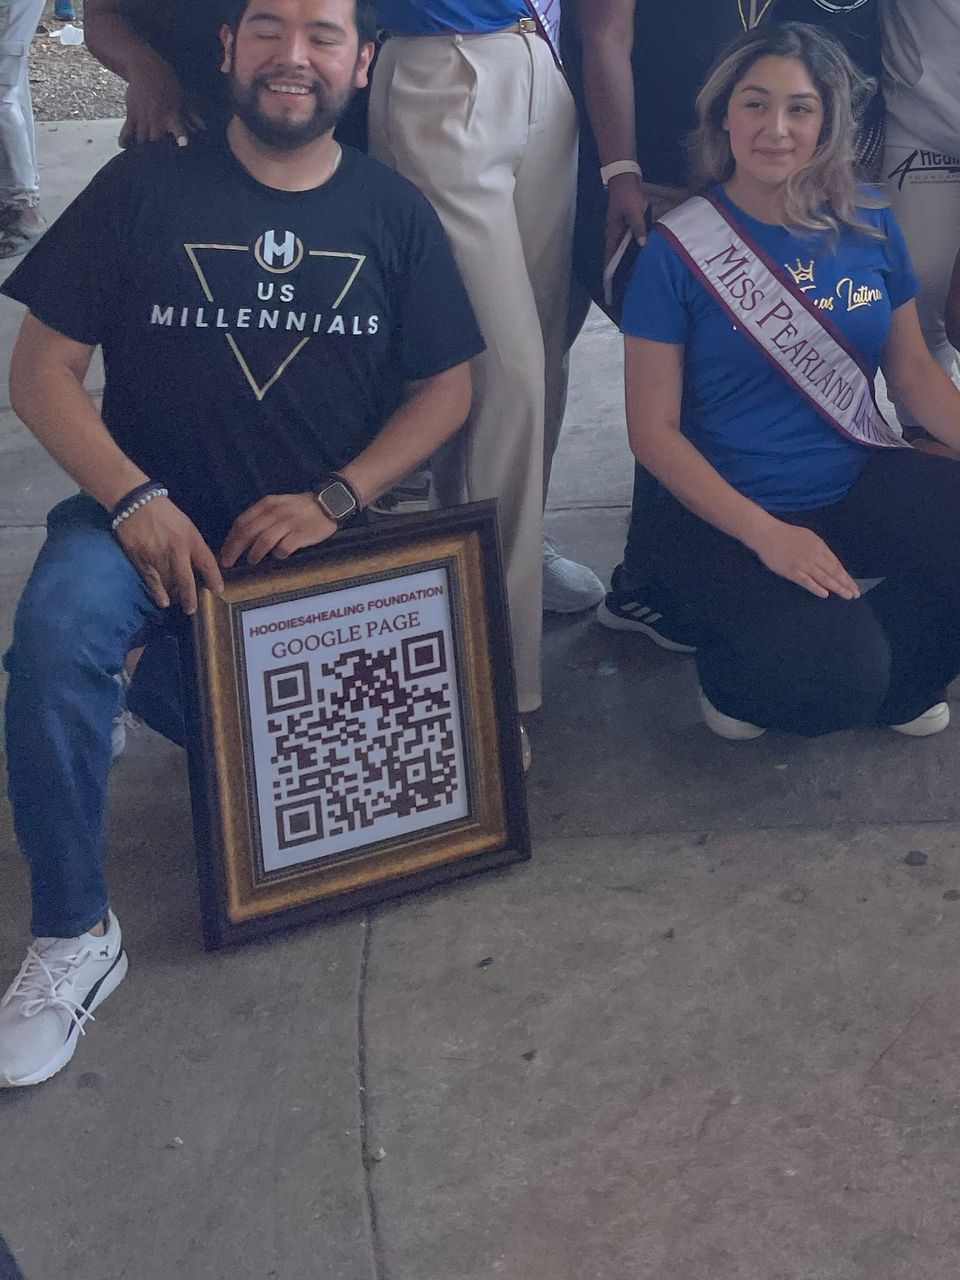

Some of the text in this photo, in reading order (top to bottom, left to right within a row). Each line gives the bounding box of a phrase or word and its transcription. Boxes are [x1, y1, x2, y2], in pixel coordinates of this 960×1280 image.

[257, 282, 296, 303] US
[150, 304, 379, 336] MILLENNIALS
[704, 243, 855, 412] MISS PEARLAND
[249, 585, 444, 638] HOODIES4HEALING FOUNDATION
[271, 611, 421, 659] GOOGLE PAGE
